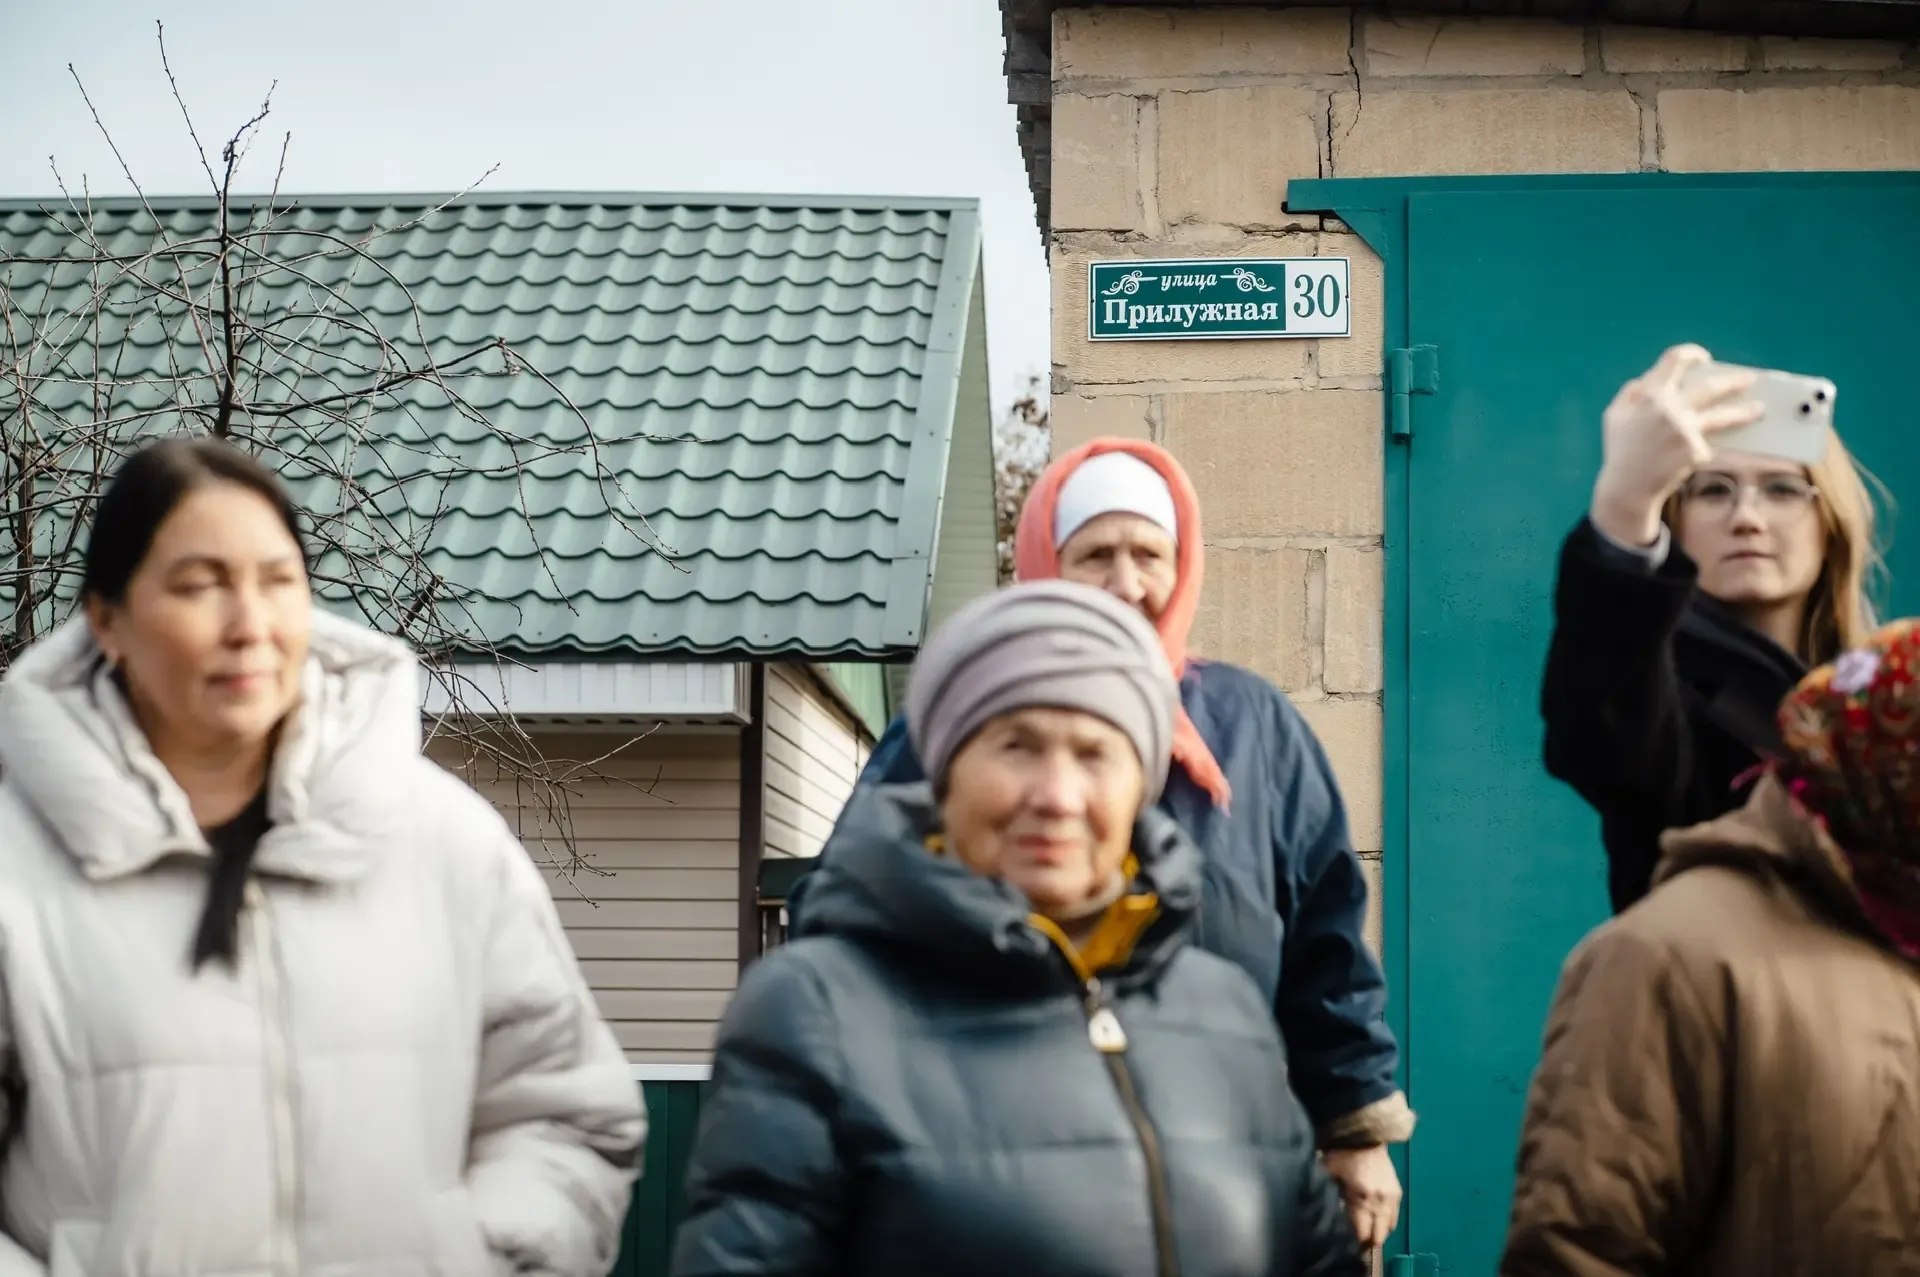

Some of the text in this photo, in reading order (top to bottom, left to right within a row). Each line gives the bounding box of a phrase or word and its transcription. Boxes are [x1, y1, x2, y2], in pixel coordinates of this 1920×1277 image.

[1161, 273, 1218, 293] улица
[1293, 274, 1340, 318] 30
[1103, 298, 1279, 329] Прилужная
